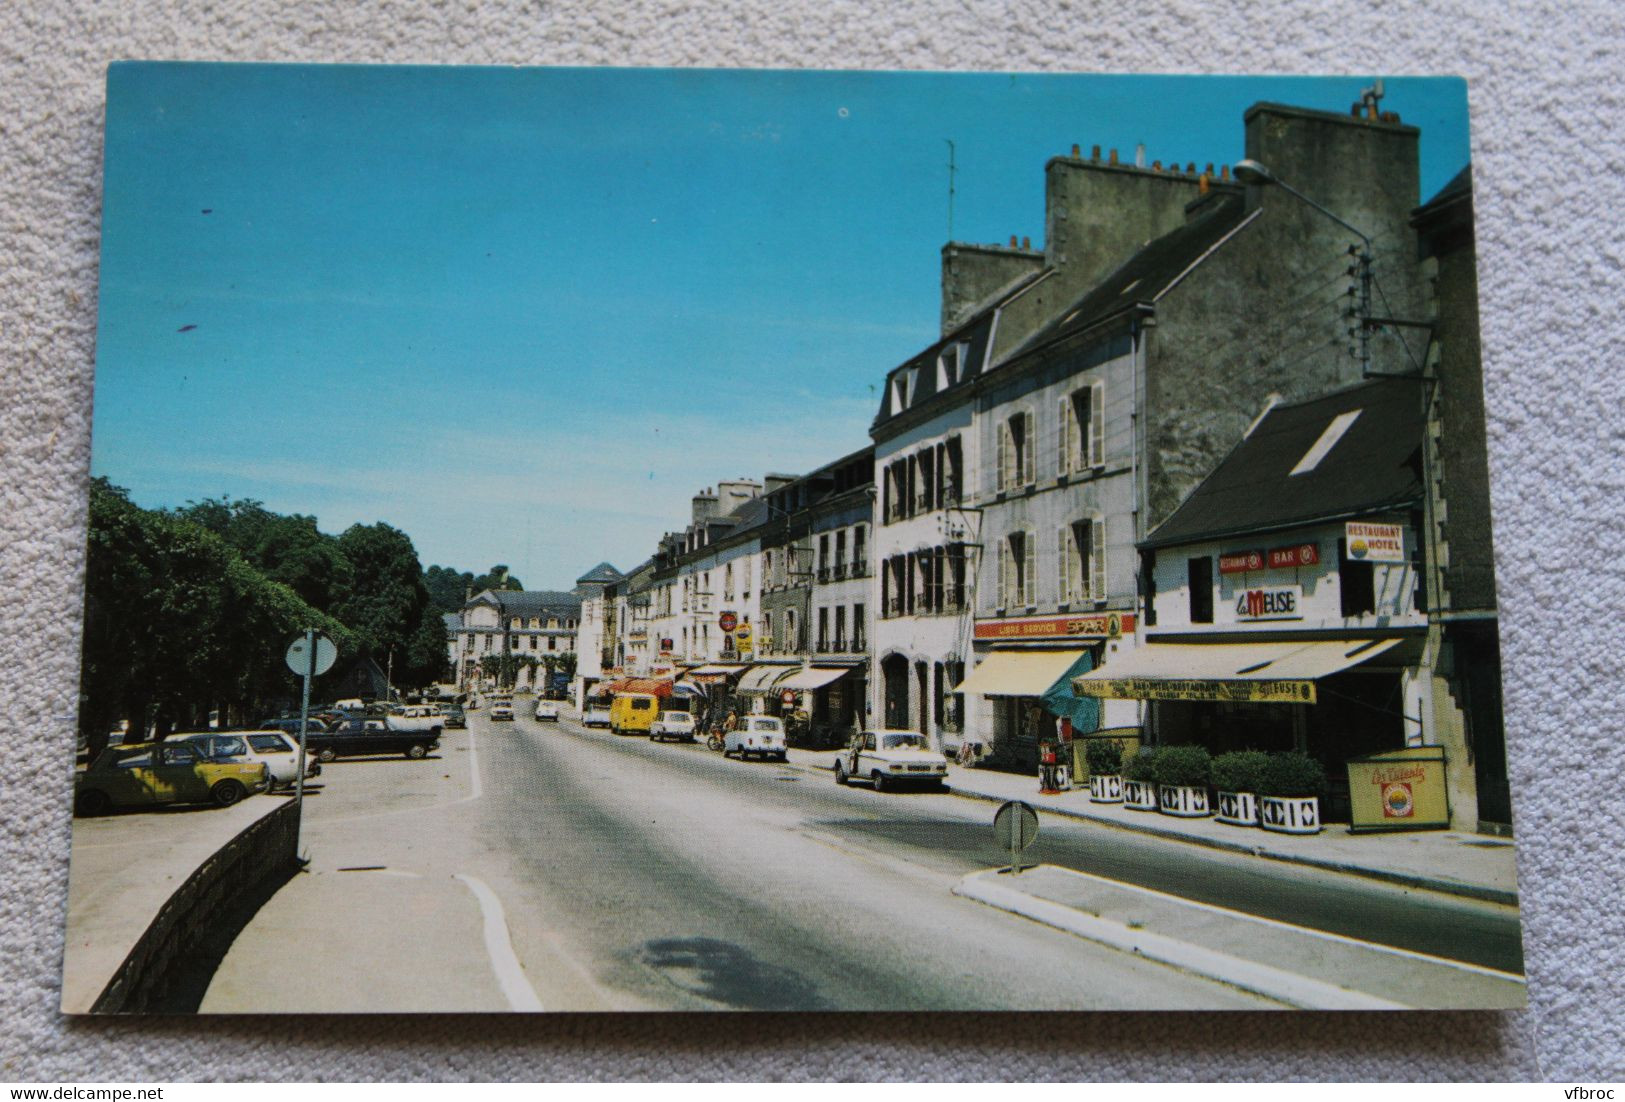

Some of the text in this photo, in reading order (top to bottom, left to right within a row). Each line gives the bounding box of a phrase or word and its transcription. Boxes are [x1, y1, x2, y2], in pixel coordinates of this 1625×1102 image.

[1347, 524, 1400, 537] RESTAURANT
[1368, 539, 1401, 550] HOTEL
[1273, 551, 1294, 563] BAR
[999, 619, 1105, 635] LIBRE SERVICE SPAR
